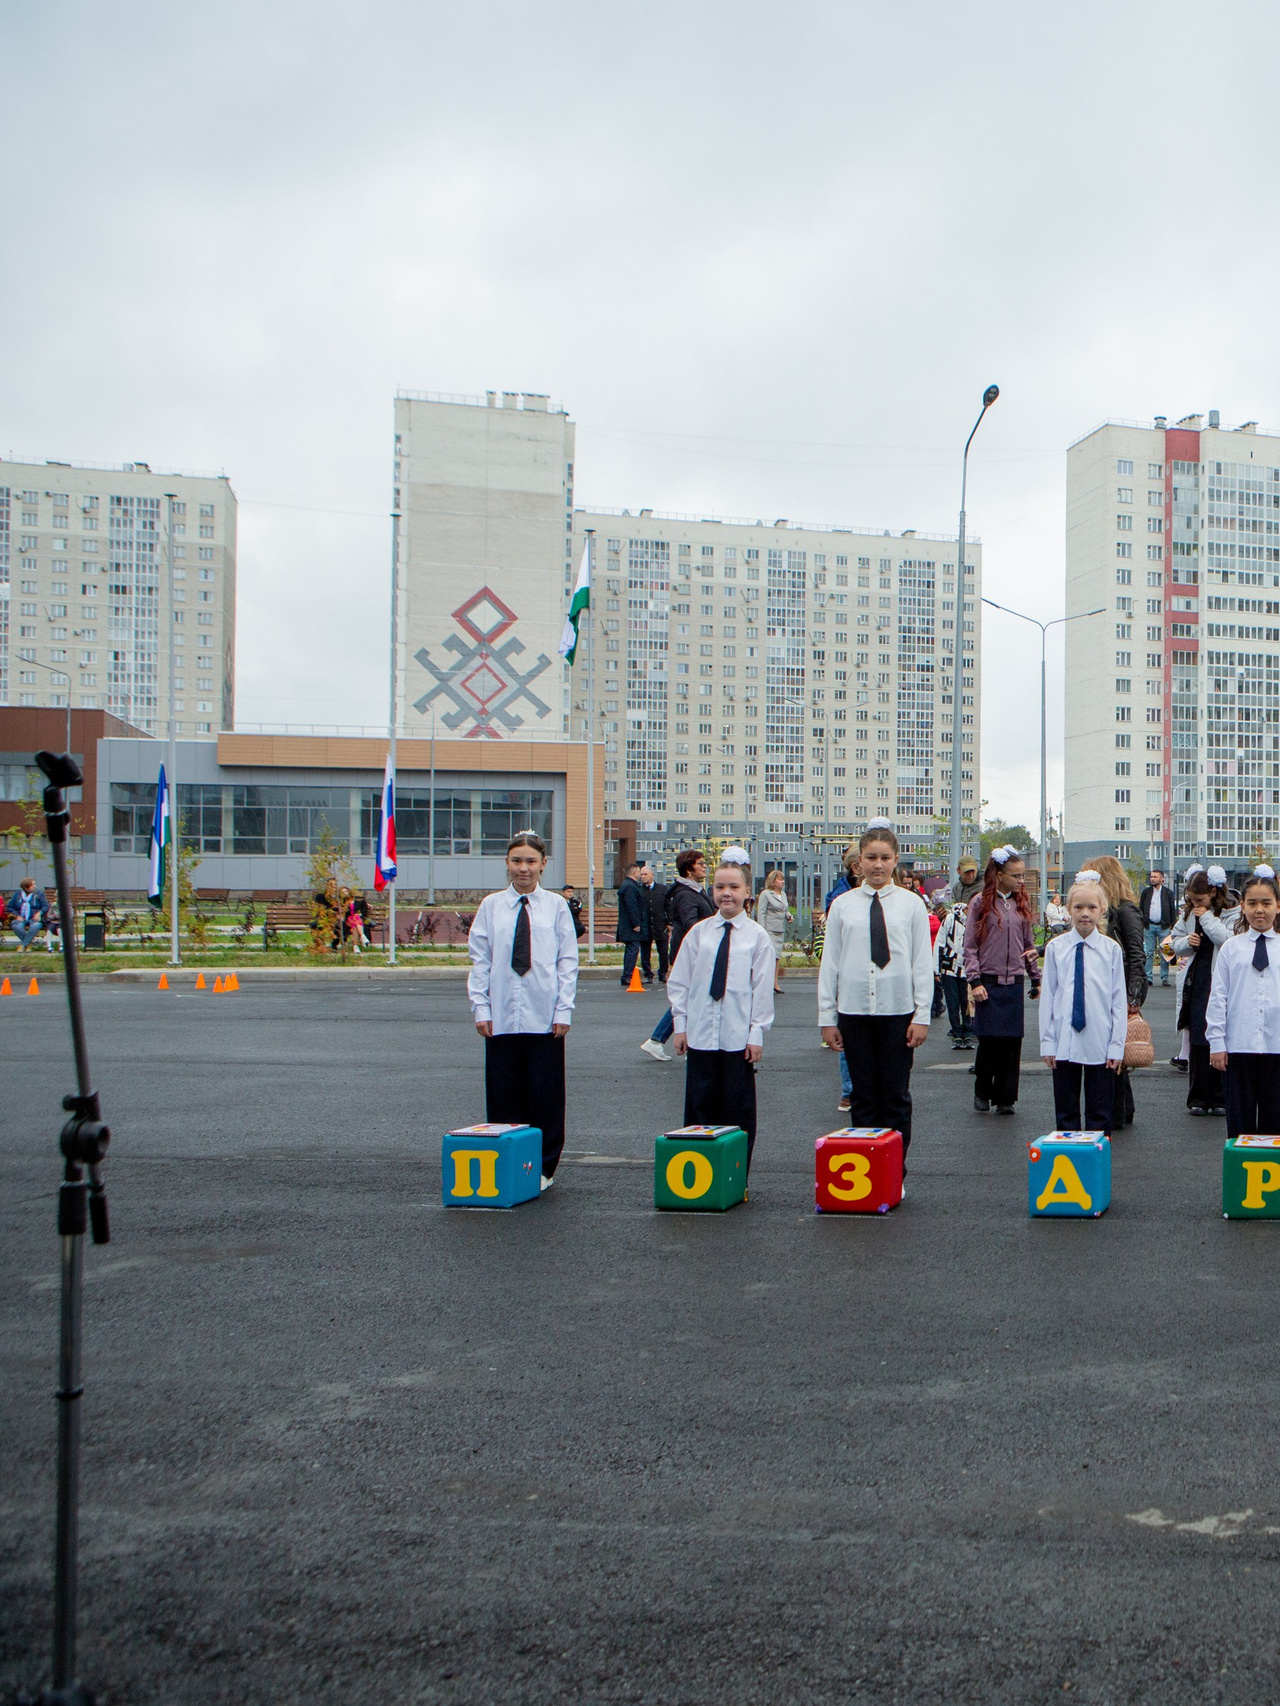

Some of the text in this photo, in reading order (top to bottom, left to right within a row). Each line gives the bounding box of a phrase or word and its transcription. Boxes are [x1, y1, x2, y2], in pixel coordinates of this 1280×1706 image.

[452, 1150, 499, 1197] П
[666, 1151, 713, 1199] О
[828, 1153, 872, 1201] З
[1036, 1154, 1092, 1210] Д
